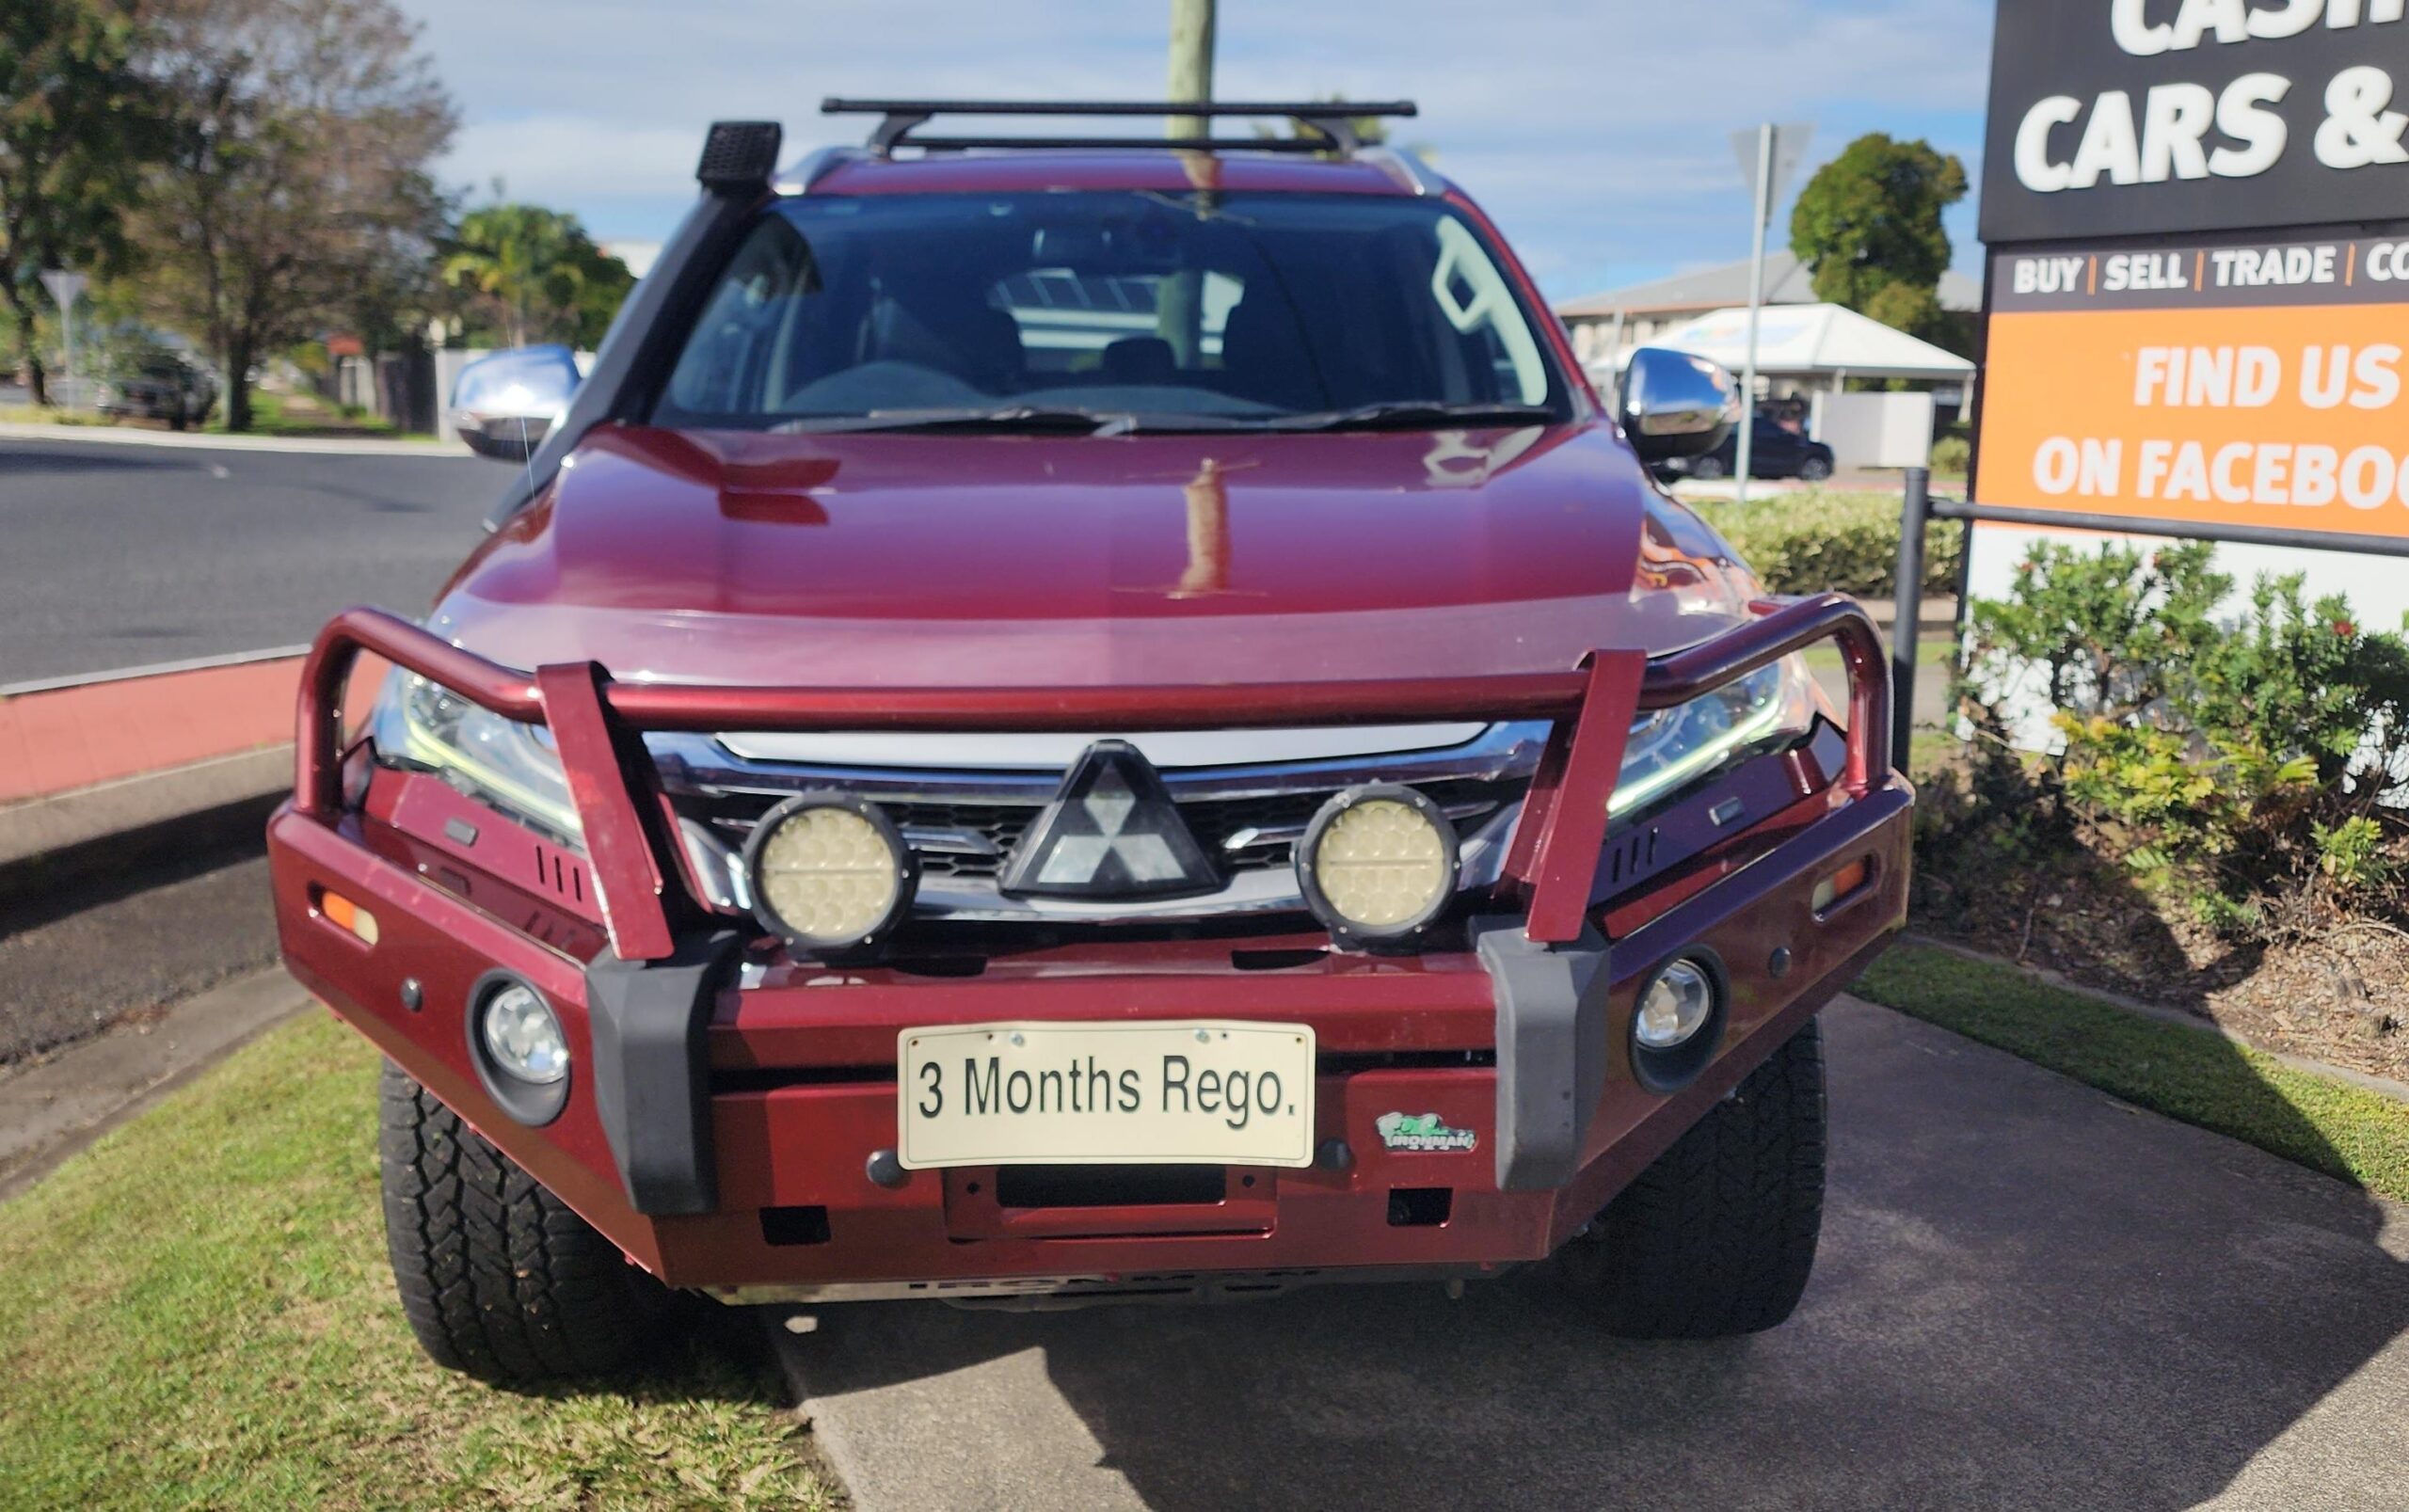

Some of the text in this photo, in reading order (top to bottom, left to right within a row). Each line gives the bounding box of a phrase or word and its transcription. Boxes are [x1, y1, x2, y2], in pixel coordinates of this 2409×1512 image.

[2014, 65, 2409, 193] CARS &
[2013, 257, 2084, 294] BUY
[2103, 252, 2189, 291] SELL
[2211, 246, 2337, 287] TRADE
[2133, 343, 2403, 410] FIND US
[2033, 437, 2409, 510] ON FACEBO
[918, 1054, 1296, 1131] 3 Months Rego.
